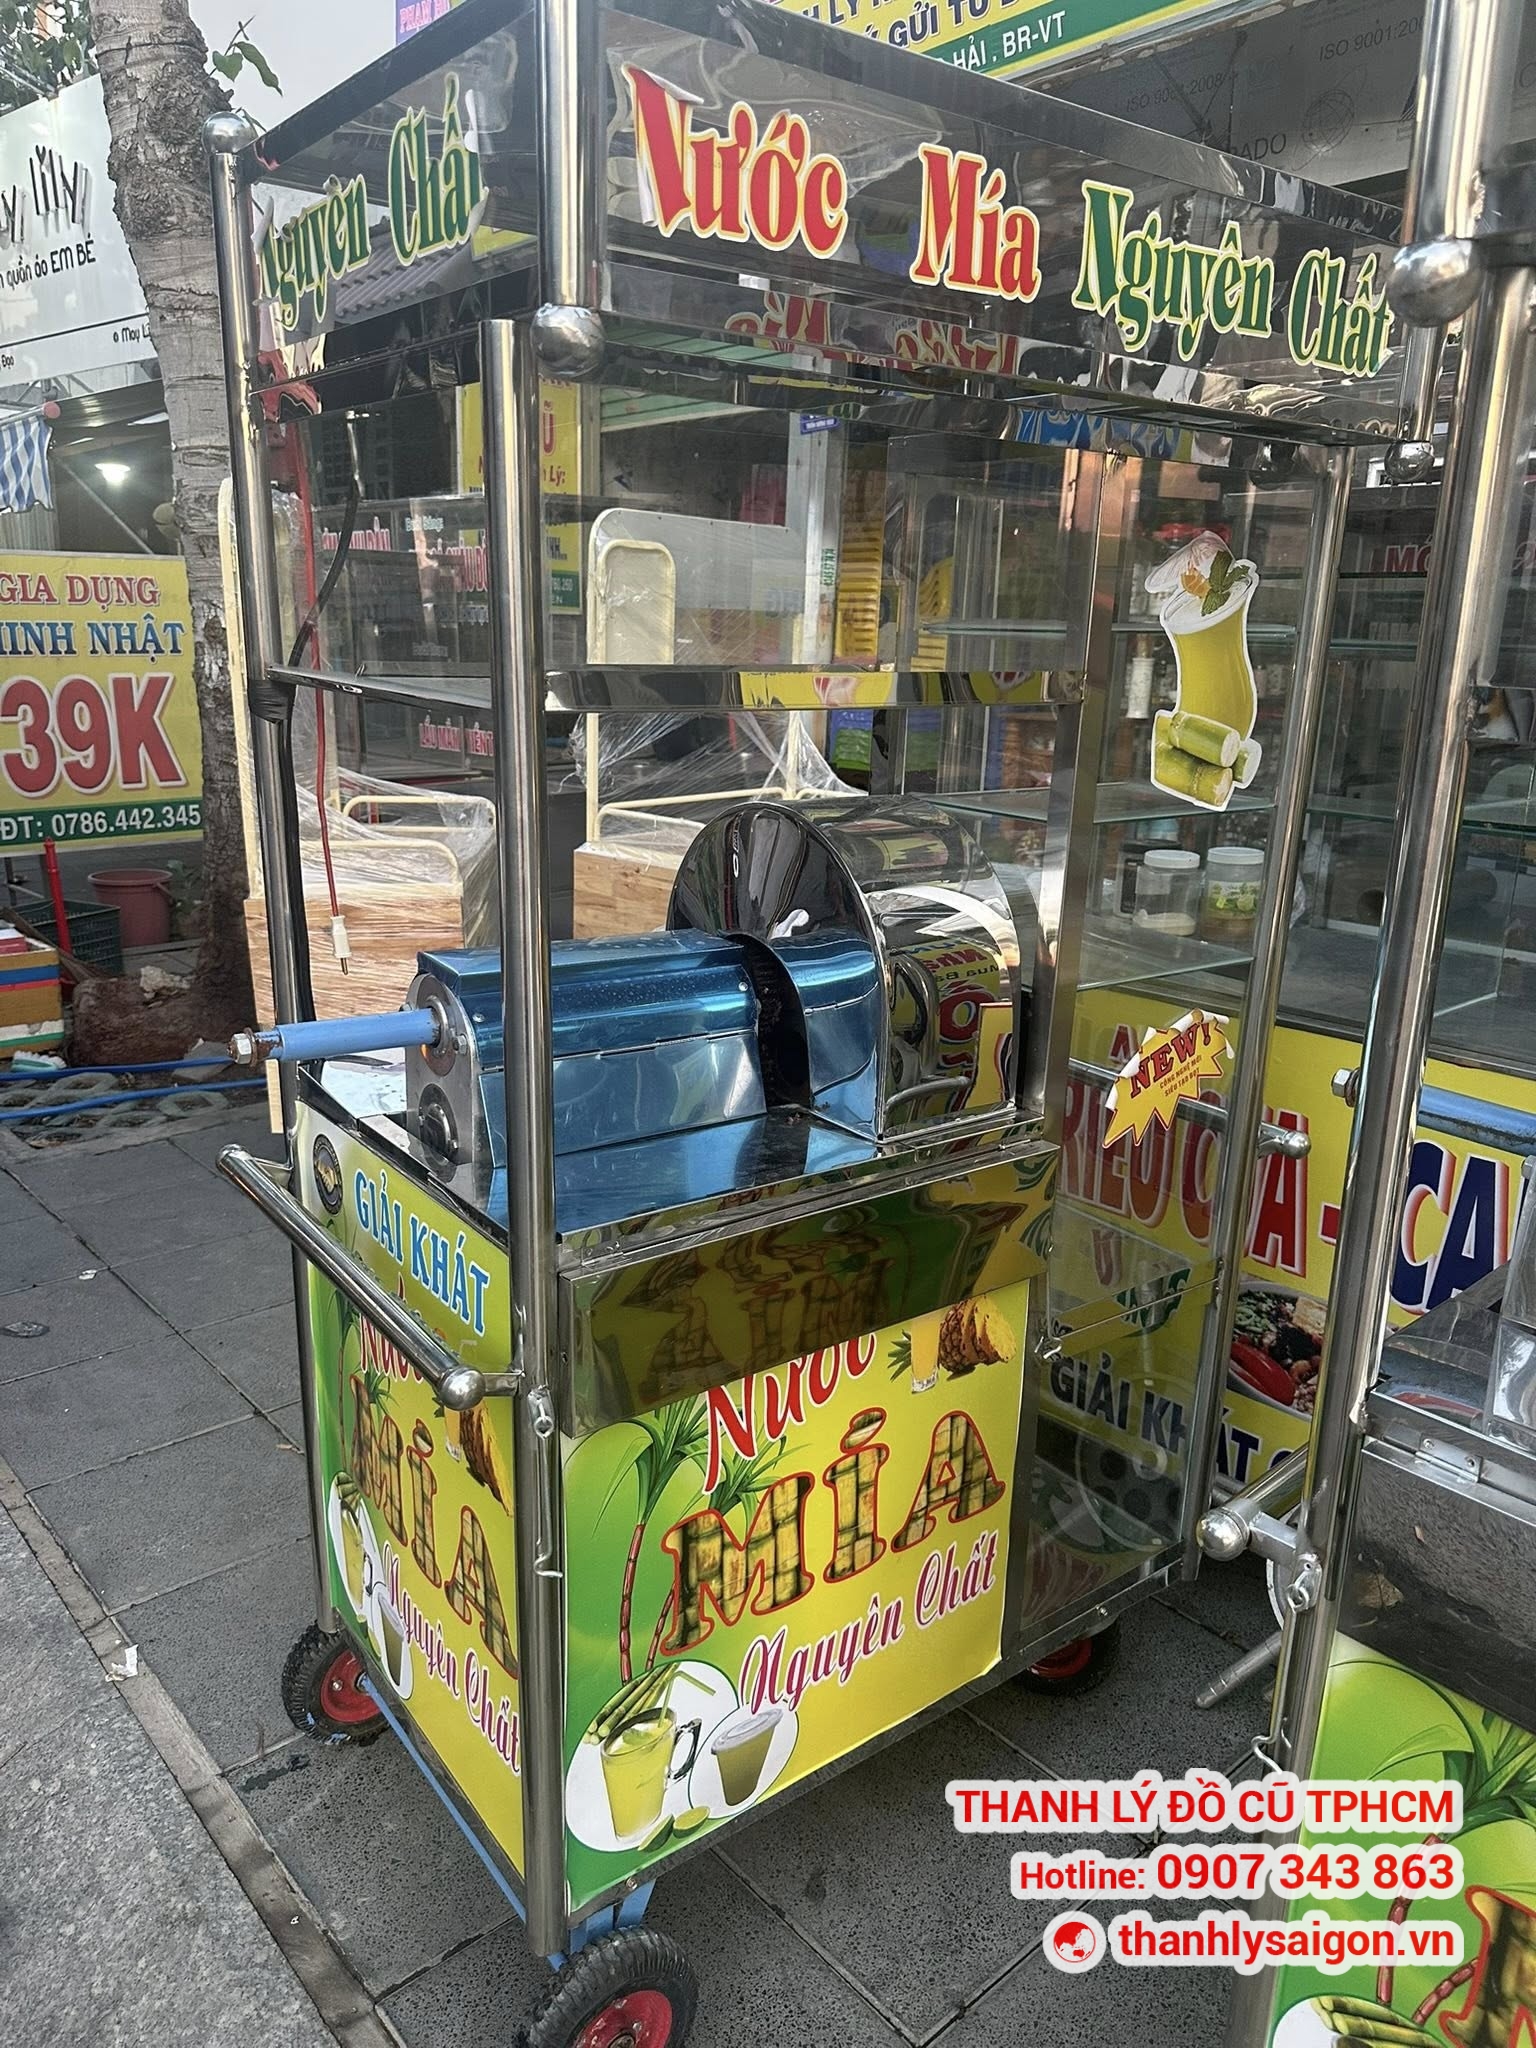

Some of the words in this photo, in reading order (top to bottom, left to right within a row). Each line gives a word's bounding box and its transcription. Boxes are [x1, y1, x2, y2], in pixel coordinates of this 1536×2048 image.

[1002, 10, 1066, 58] BR-VT
[621, 62, 849, 259] Nước
[909, 143, 1041, 303] Mía
[1072, 179, 1274, 361] Nguyên
[1288, 247, 1396, 378] Chất
[34, 254, 48, 278] áo
[50, 246, 74, 273] EM
[76, 232, 96, 267] BÉ
[0, 571, 58, 604] GIA
[66, 573, 159, 611] DỤNG
[87, 613, 186, 663] NHẬT
[51, 803, 201, 838] 0786.442.345
[354, 1168, 405, 1266] GIẢI
[410, 1212, 492, 1338] KHÁT
[658, 1406, 1007, 1657] MÍA
[739, 1595, 904, 1716] Nguyên
[914, 1531, 999, 1630] Chất
